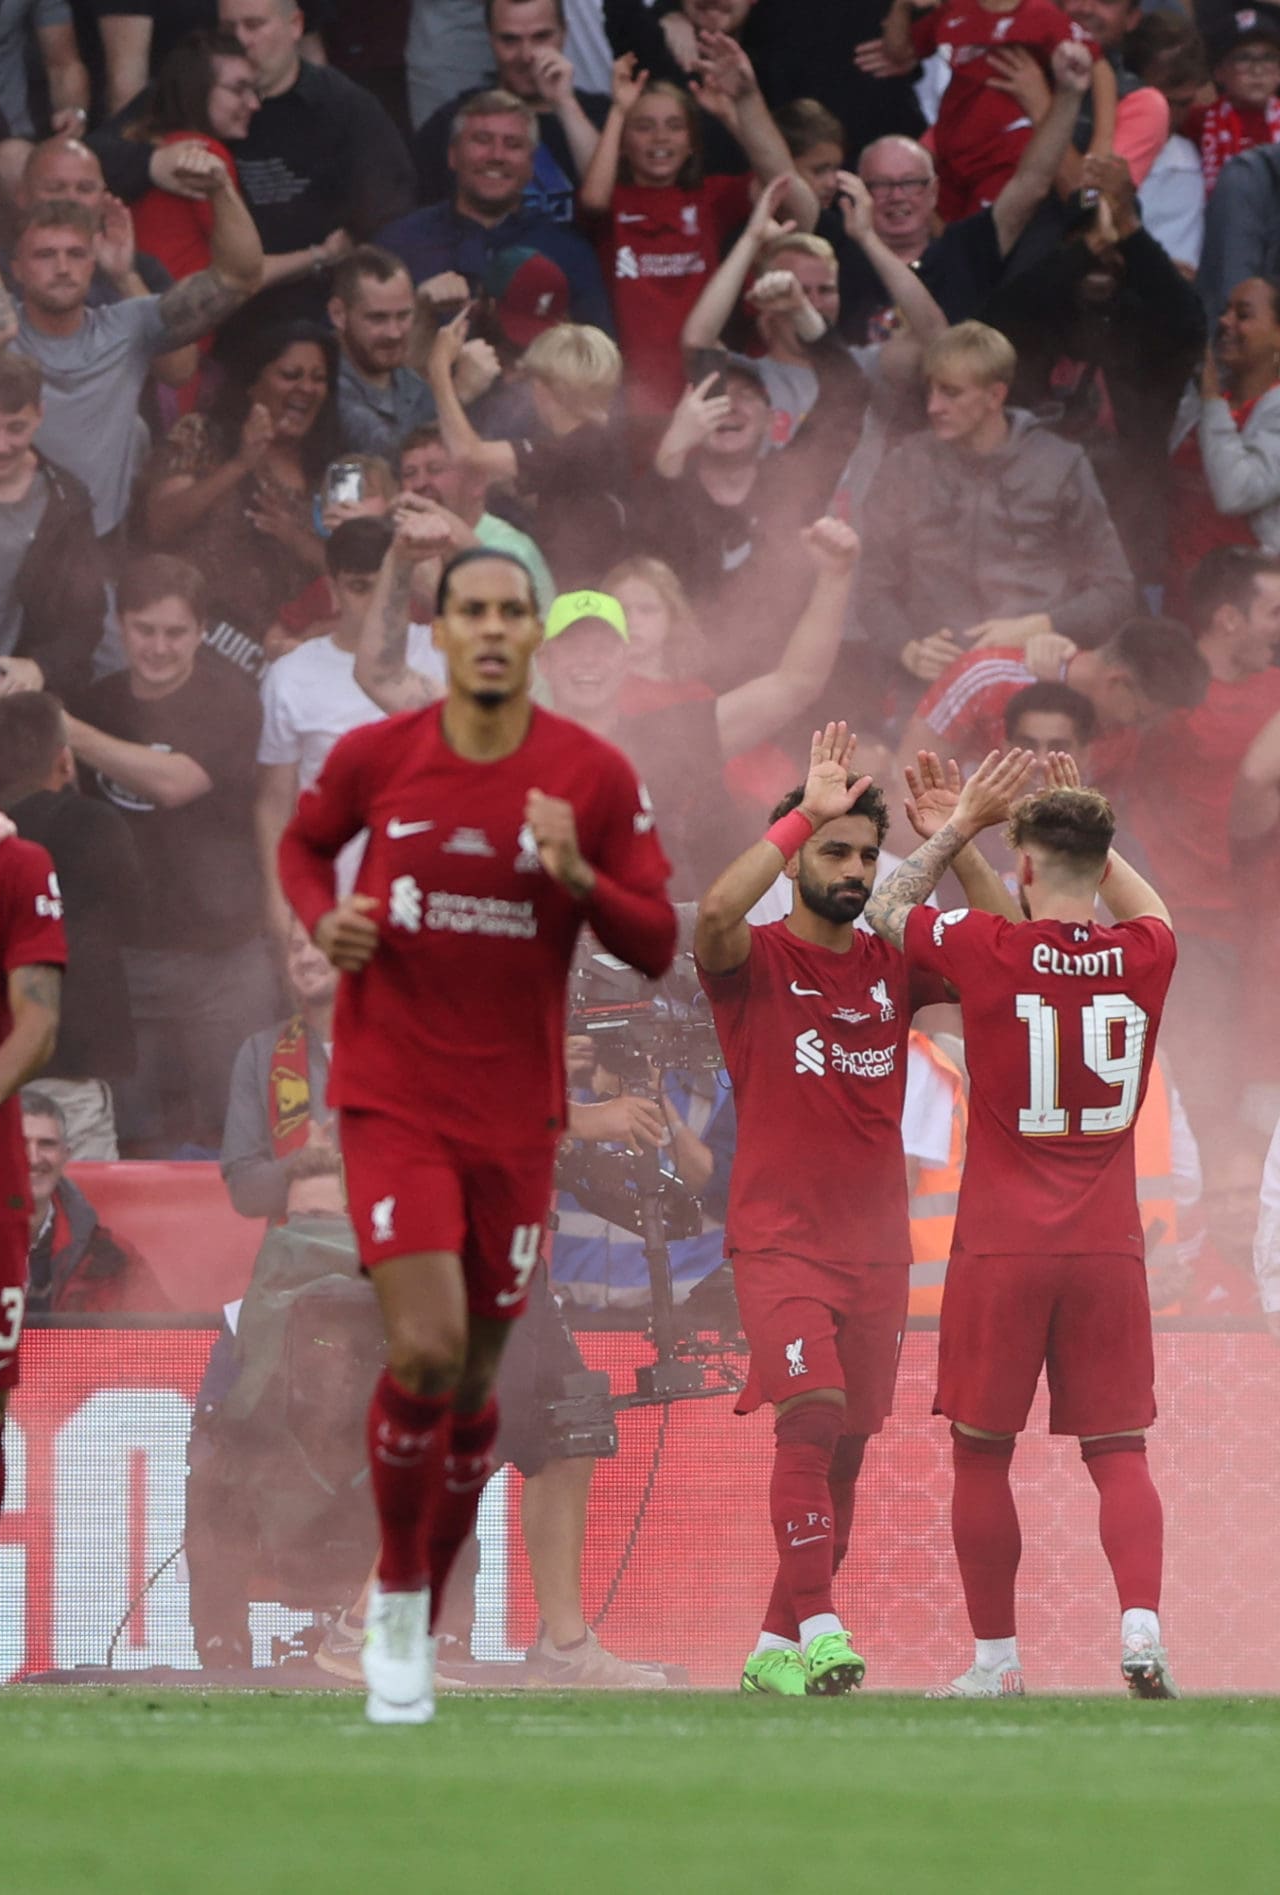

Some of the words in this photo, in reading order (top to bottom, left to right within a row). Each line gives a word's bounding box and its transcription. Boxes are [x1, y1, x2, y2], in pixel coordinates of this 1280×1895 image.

[1015, 993, 1150, 1136] 19
[509, 1222, 542, 1288] 4
[788, 1363, 809, 1378] LFC
